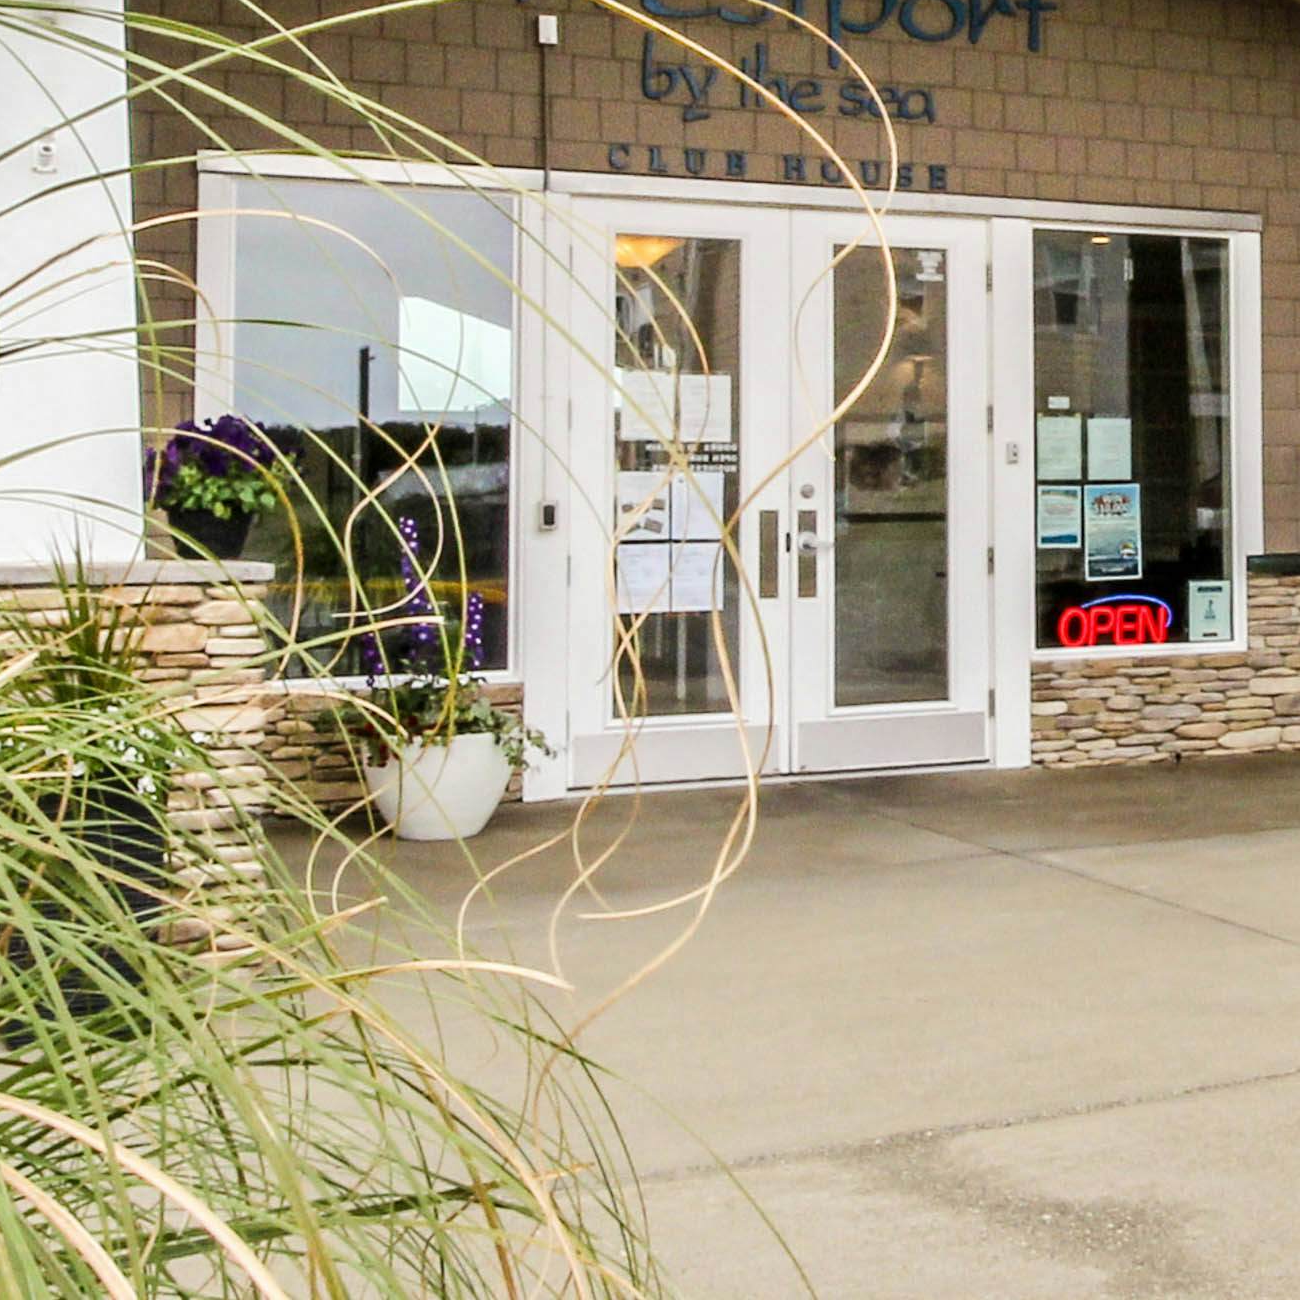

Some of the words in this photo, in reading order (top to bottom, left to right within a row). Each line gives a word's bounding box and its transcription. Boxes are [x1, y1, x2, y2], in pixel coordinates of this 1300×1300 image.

[642, 32, 717, 122] by
[741, 42, 826, 113] the
[838, 79, 936, 124] sea
[607, 143, 746, 176] CLUB
[784, 155, 948, 190] HOUSE
[1057, 605, 1168, 648] OPEN
